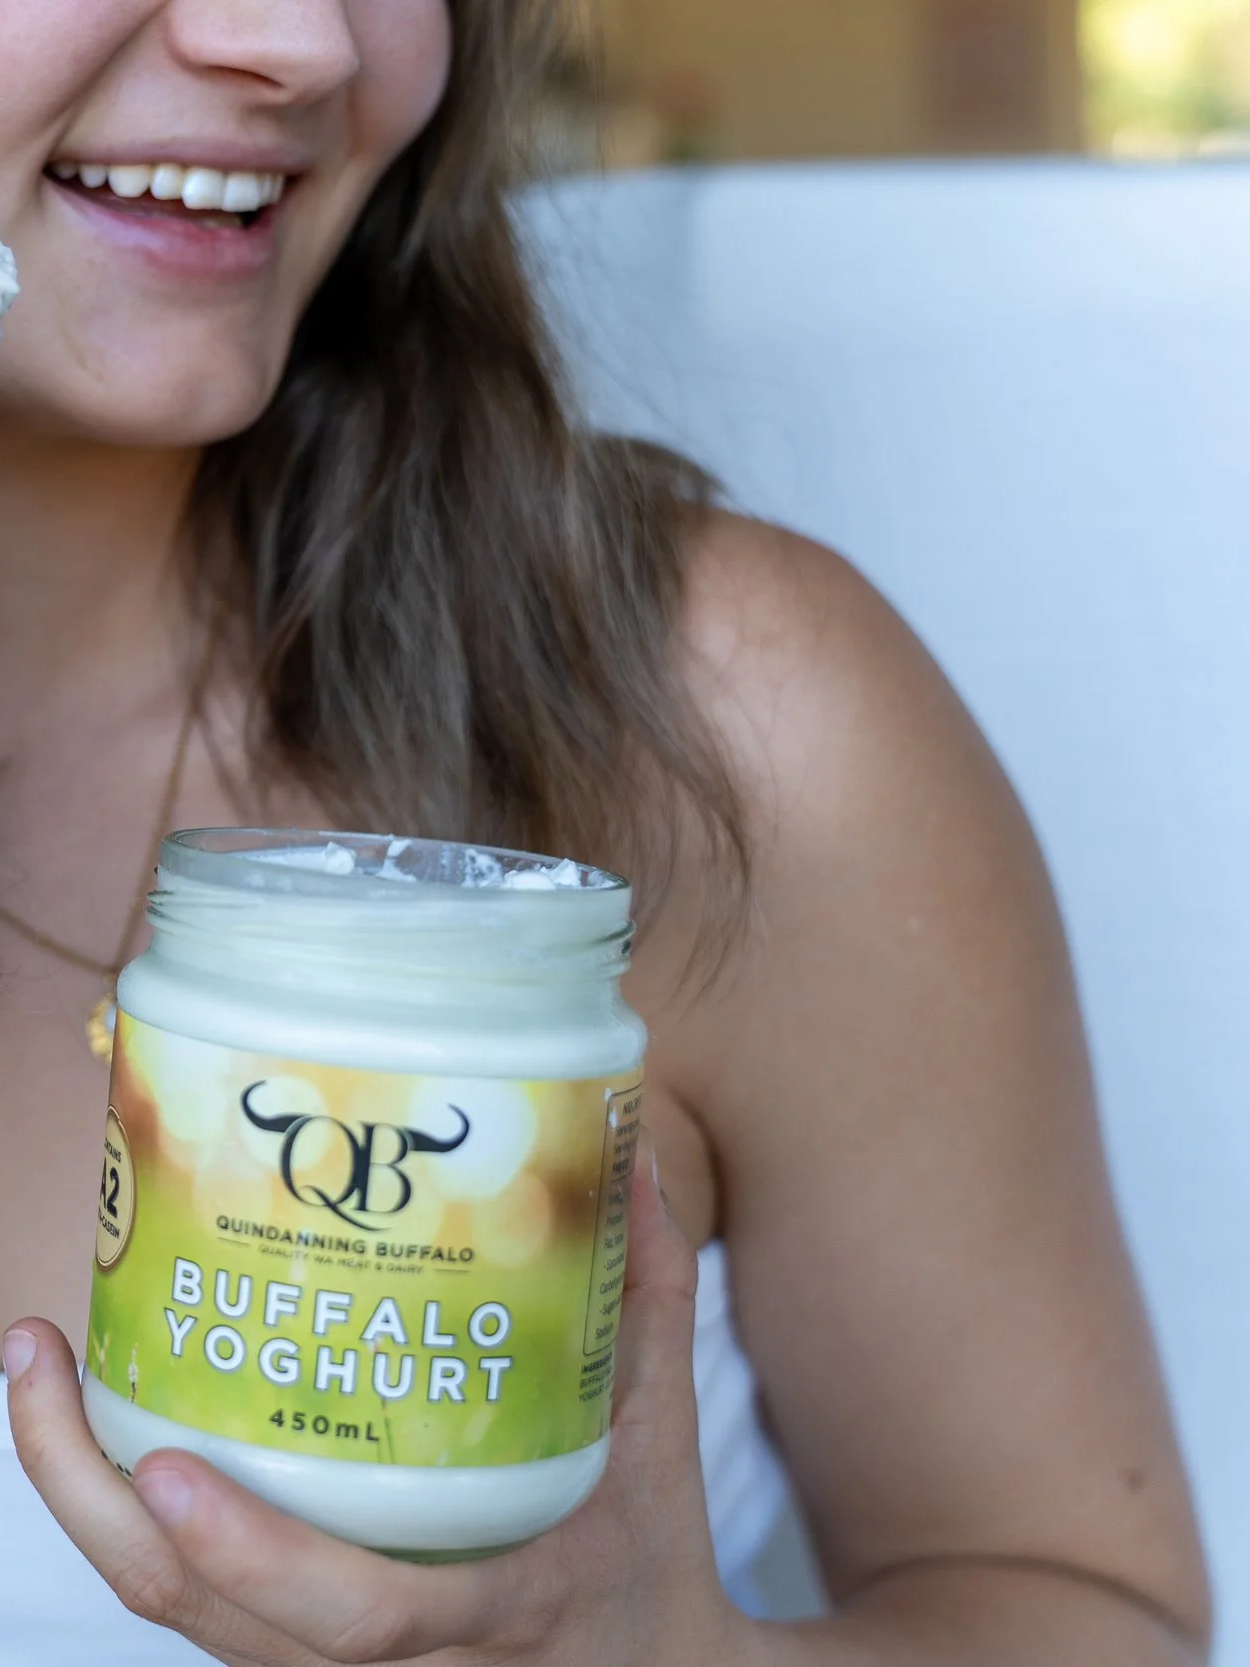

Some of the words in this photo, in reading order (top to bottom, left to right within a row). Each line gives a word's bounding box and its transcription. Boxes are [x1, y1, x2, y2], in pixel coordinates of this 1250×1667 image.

[99, 1157, 120, 1219] A2
[280, 1114, 412, 1231] QB
[216, 1215, 367, 1255] QUINDANNING
[375, 1241, 475, 1263] BUFFALO
[258, 1243, 309, 1261] QUALITY
[171, 1256, 513, 1349] BUFFALO
[164, 1307, 514, 1403] YOGHURT
[269, 1408, 382, 1443] 450mL
